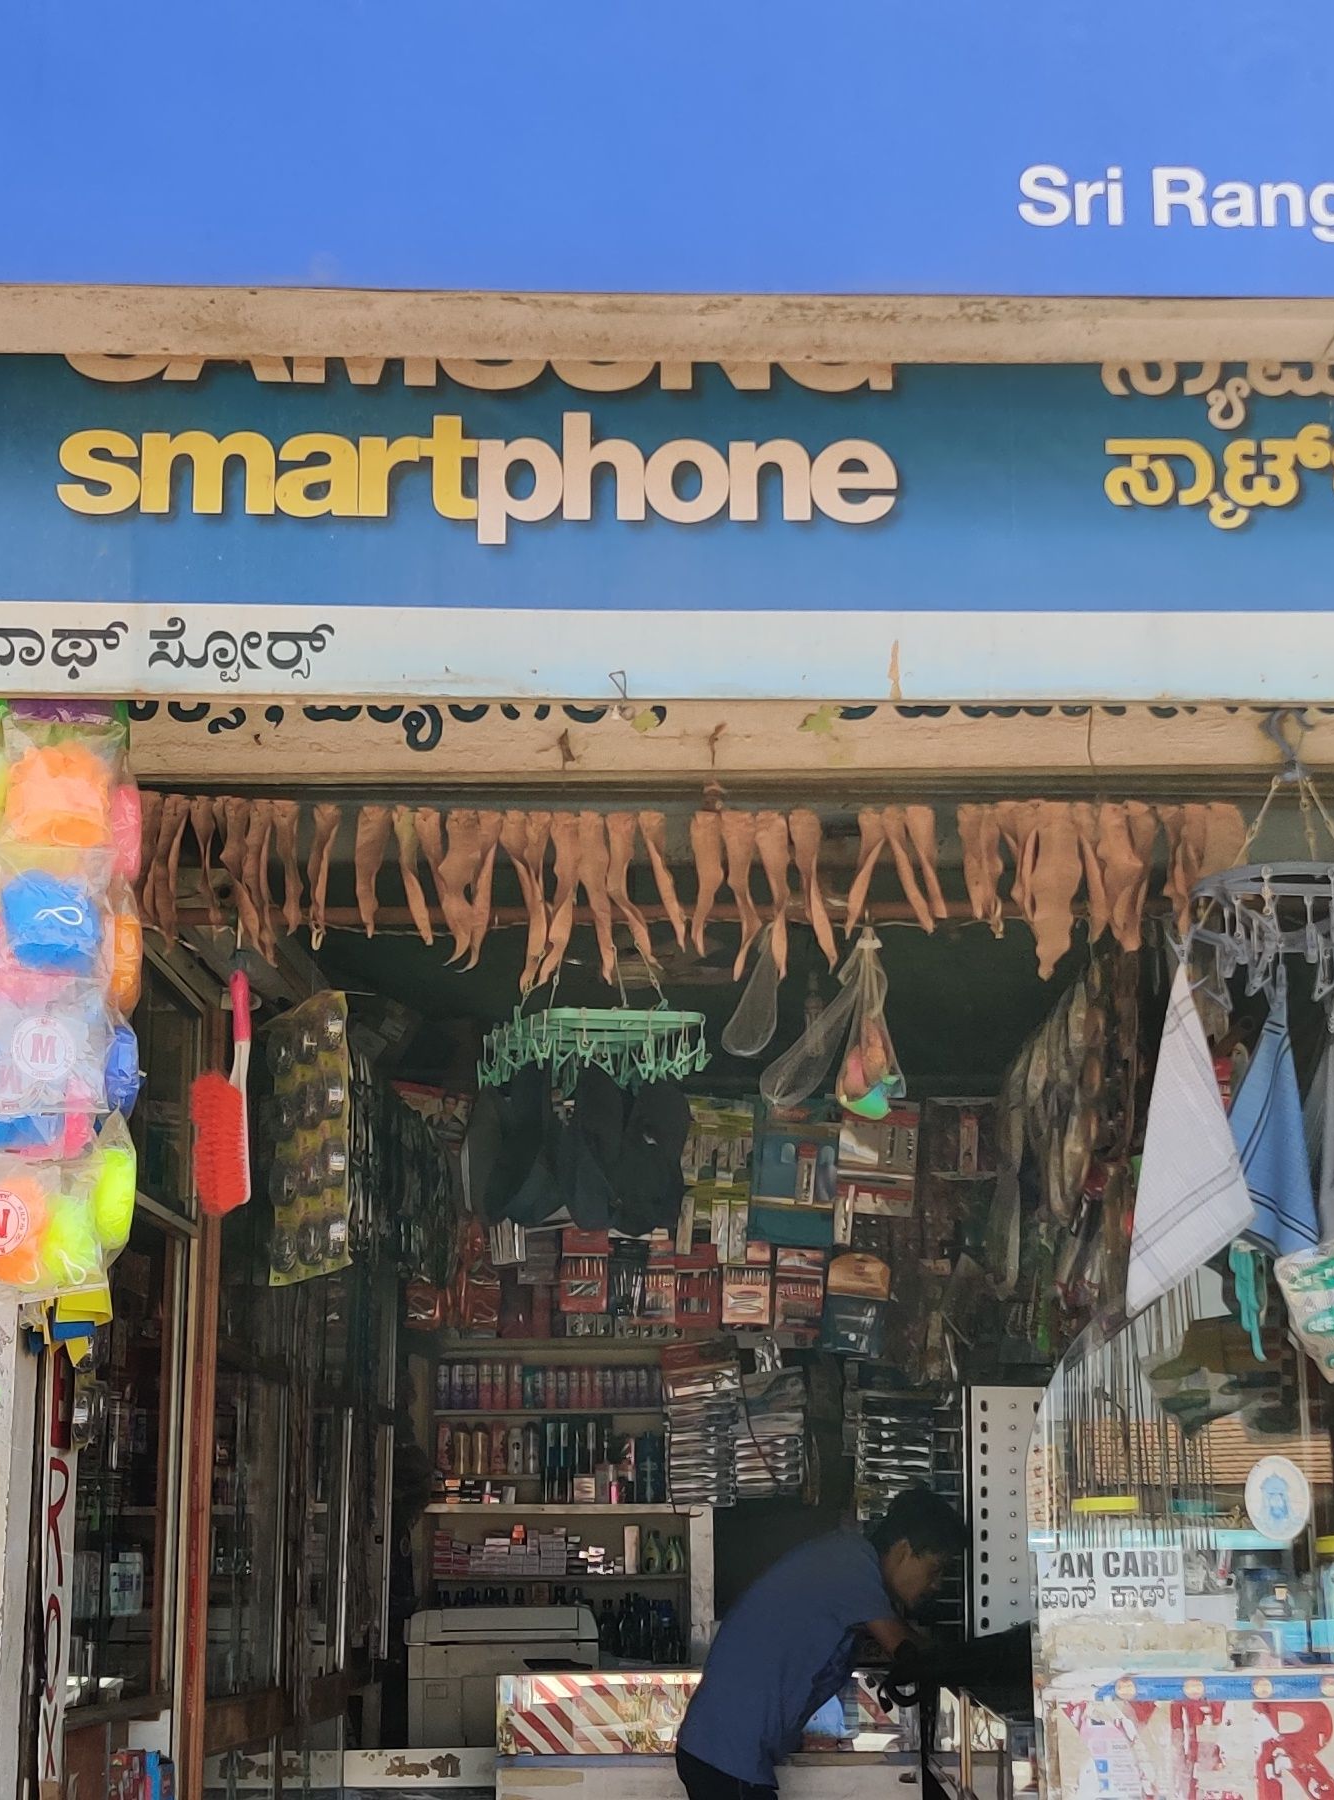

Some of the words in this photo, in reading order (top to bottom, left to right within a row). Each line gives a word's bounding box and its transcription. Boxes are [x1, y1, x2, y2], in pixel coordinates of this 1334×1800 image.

[1018, 164, 1123, 228] Sri
[56, 410, 899, 546] smartphone
[1102, 1550, 1180, 1578] CARD
